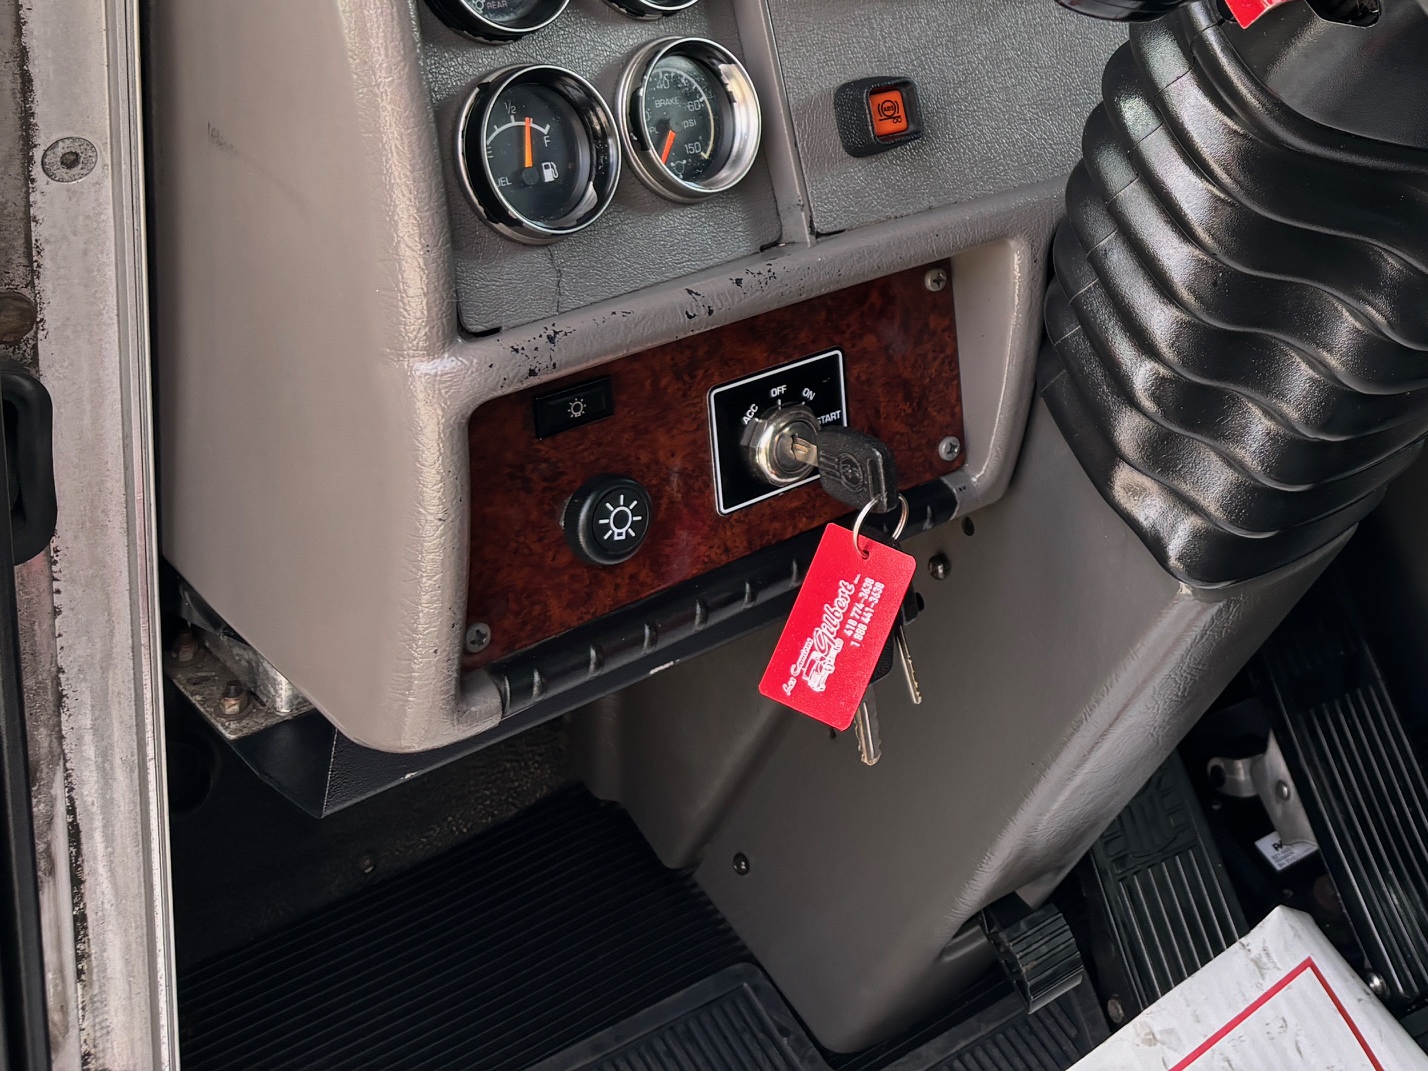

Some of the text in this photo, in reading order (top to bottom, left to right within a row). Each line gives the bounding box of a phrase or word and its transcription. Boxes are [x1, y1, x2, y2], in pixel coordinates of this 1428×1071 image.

[486, 0, 508, 10] REAR
[654, 97, 680, 108] BRAKE
[687, 100, 701, 111] 60
[682, 119, 697, 130] psi
[543, 135, 551, 147] F
[685, 142, 702, 155] 150
[770, 384, 787, 398] OFF
[802, 387, 816, 401] ON
[742, 403, 759, 425] ACC
[850, 577, 875, 620] 774-3638
[853, 623, 868, 641] 888
[861, 582, 885, 624] 441-3638
[843, 618, 858, 637] 418
[782, 637, 813, 696] Les Camions
